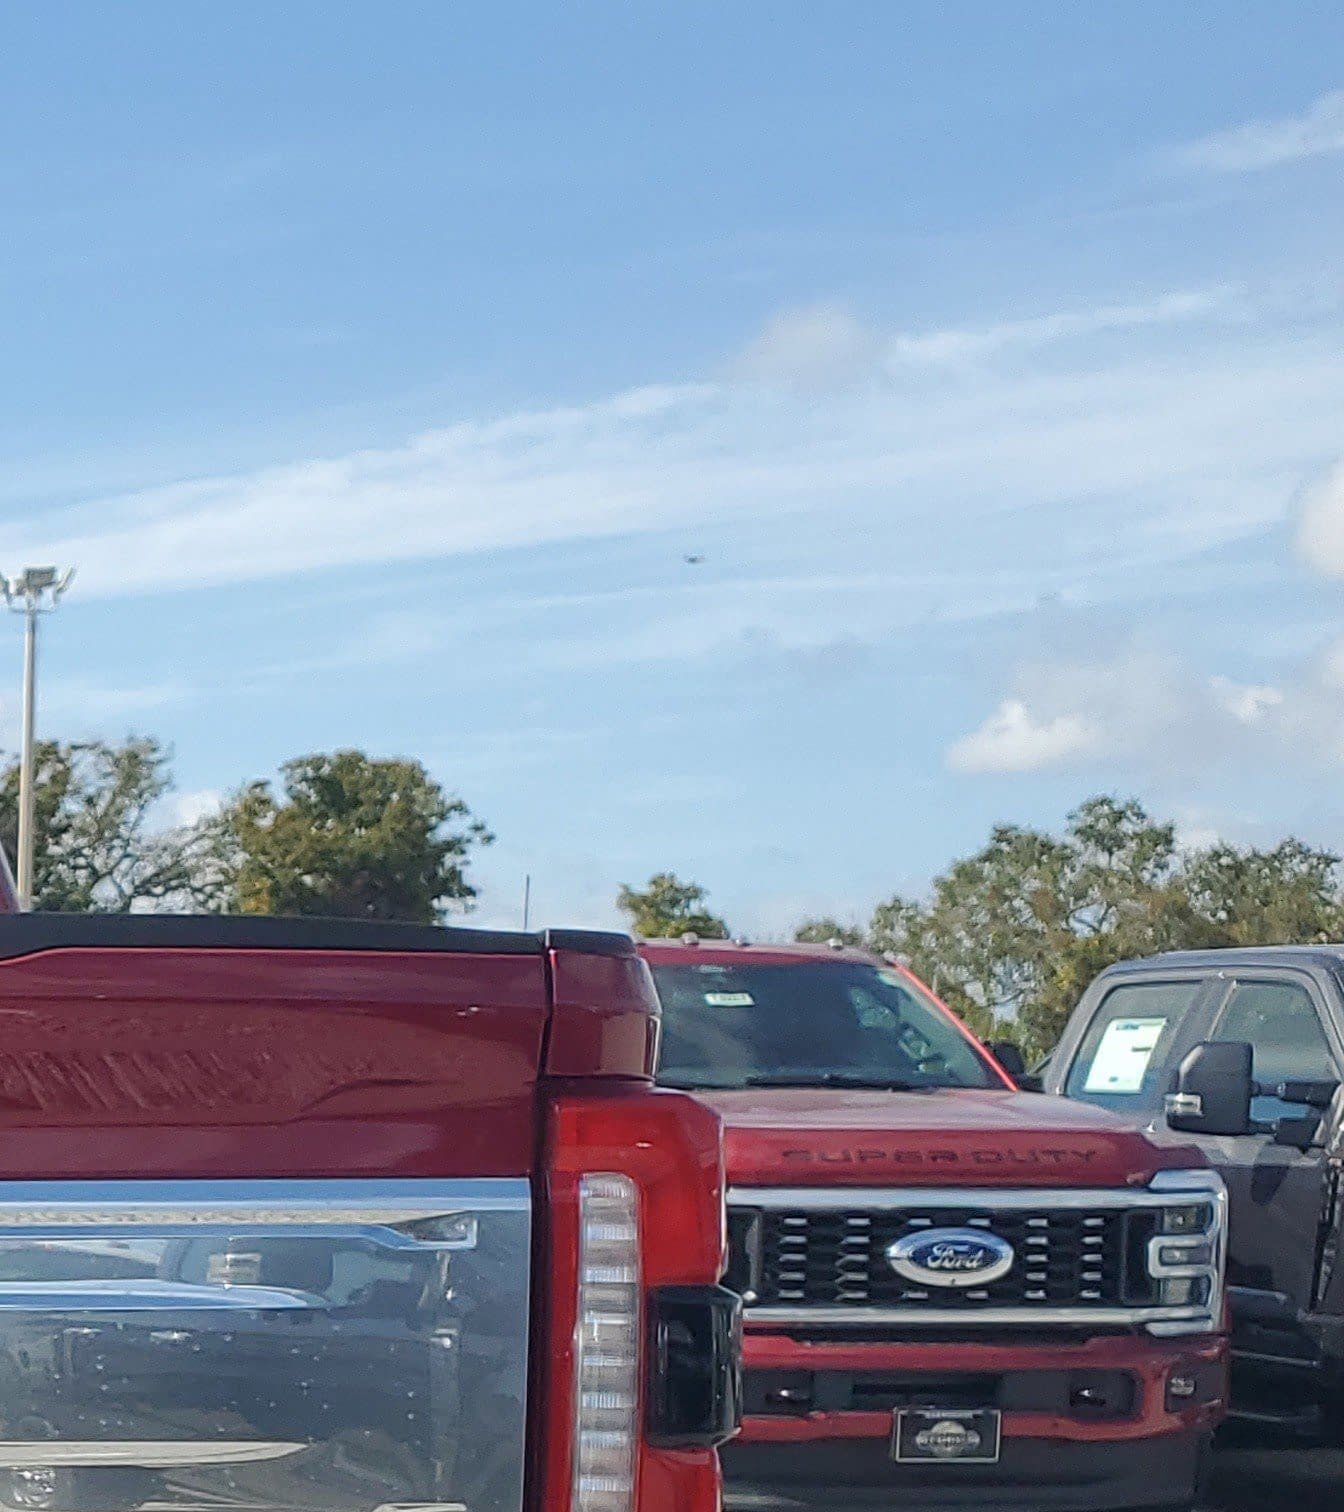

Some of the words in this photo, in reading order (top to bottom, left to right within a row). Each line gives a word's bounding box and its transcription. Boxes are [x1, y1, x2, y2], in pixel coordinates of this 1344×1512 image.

[781, 1149, 961, 1163] SUPER
[971, 1148, 1099, 1164] DUTY
[926, 1242, 985, 1270] Ford
